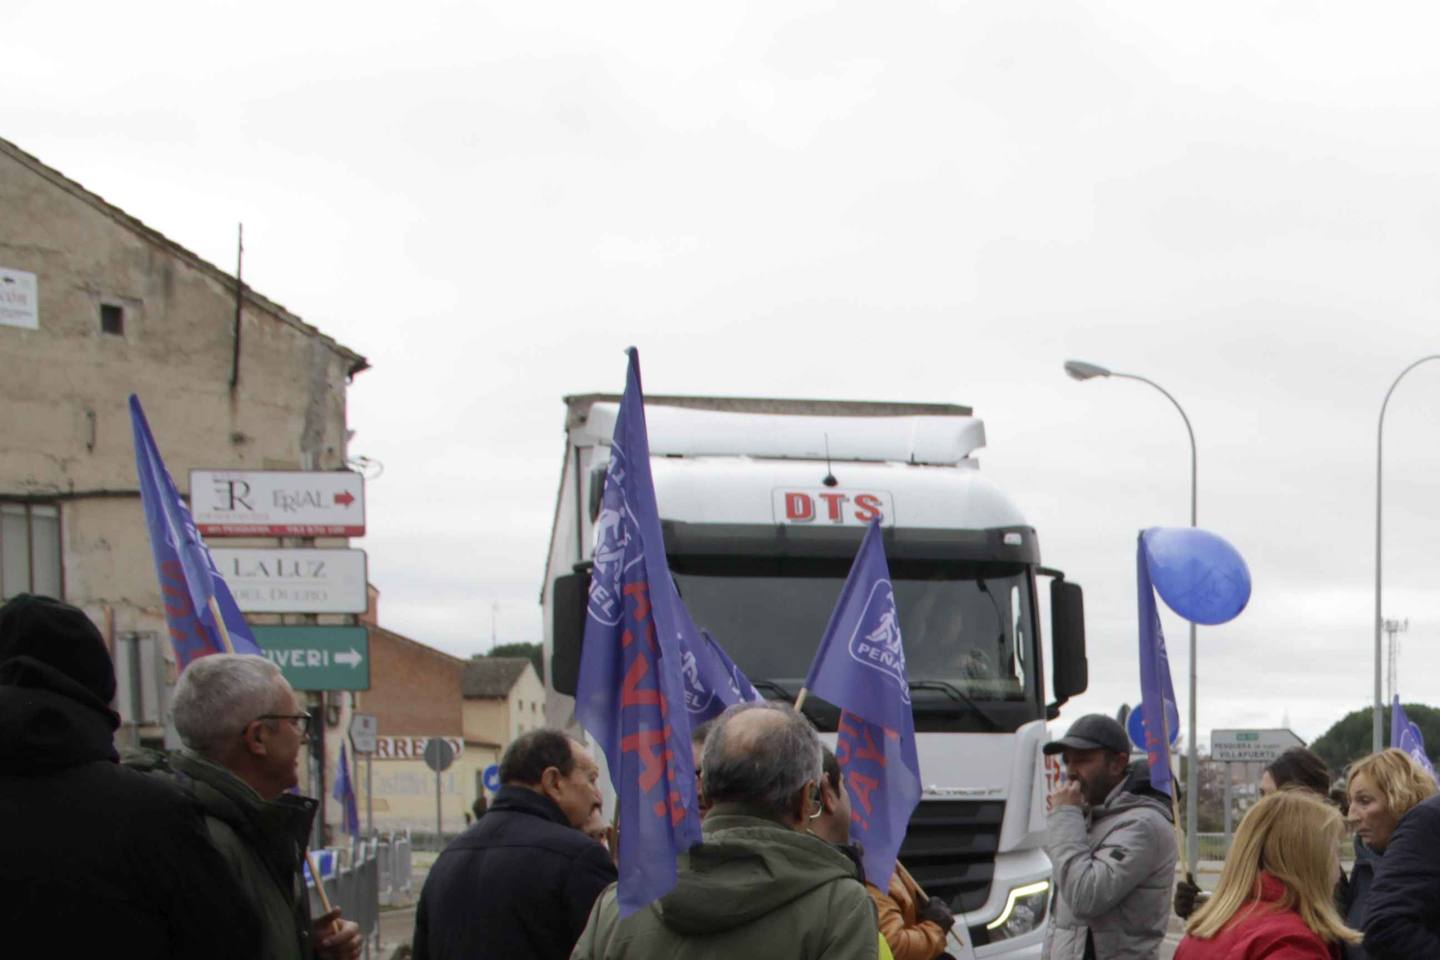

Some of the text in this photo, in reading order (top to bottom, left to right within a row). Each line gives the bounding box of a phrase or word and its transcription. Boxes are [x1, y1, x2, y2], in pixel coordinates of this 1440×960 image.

[784, 492, 881, 524] DTS
[233, 557, 326, 578] LA LUZ
